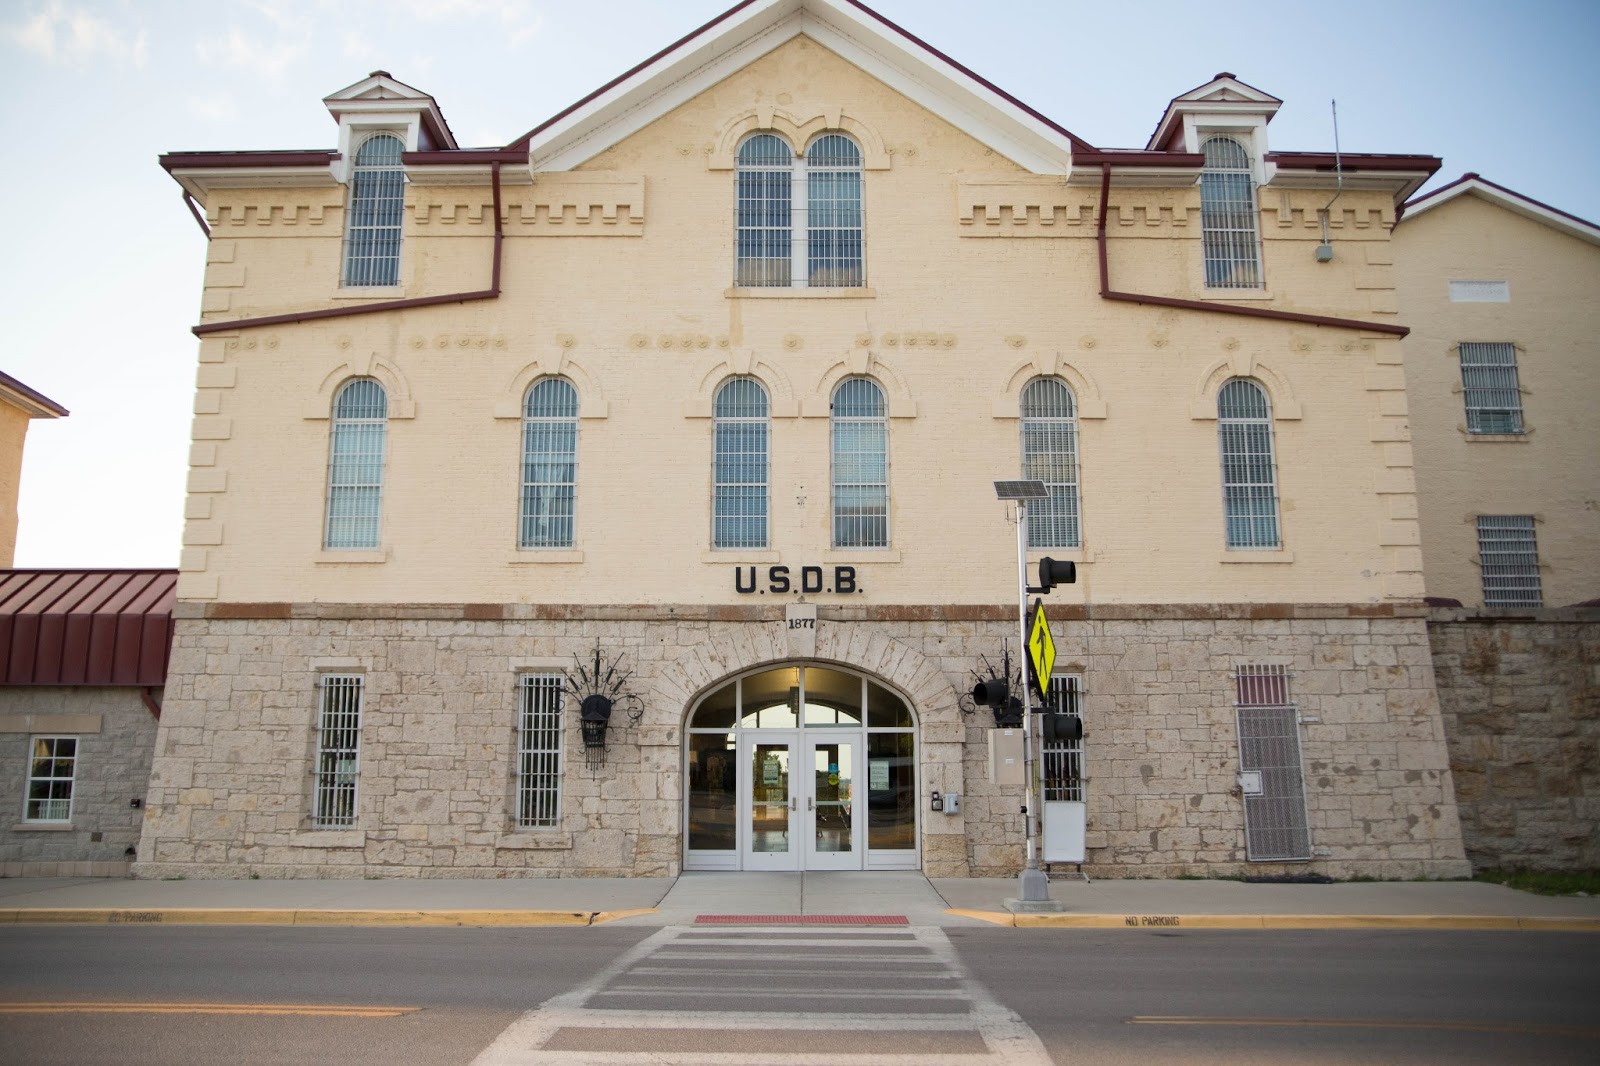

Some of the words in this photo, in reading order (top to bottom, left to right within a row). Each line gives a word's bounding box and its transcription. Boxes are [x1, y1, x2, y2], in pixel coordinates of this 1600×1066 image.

[735, 566, 864, 594] U.S.D.B.
[788, 618, 815, 630] 1877
[124, 911, 163, 922] PARKING
[1125, 916, 1138, 926] NO
[1142, 916, 1179, 926] PARKING
